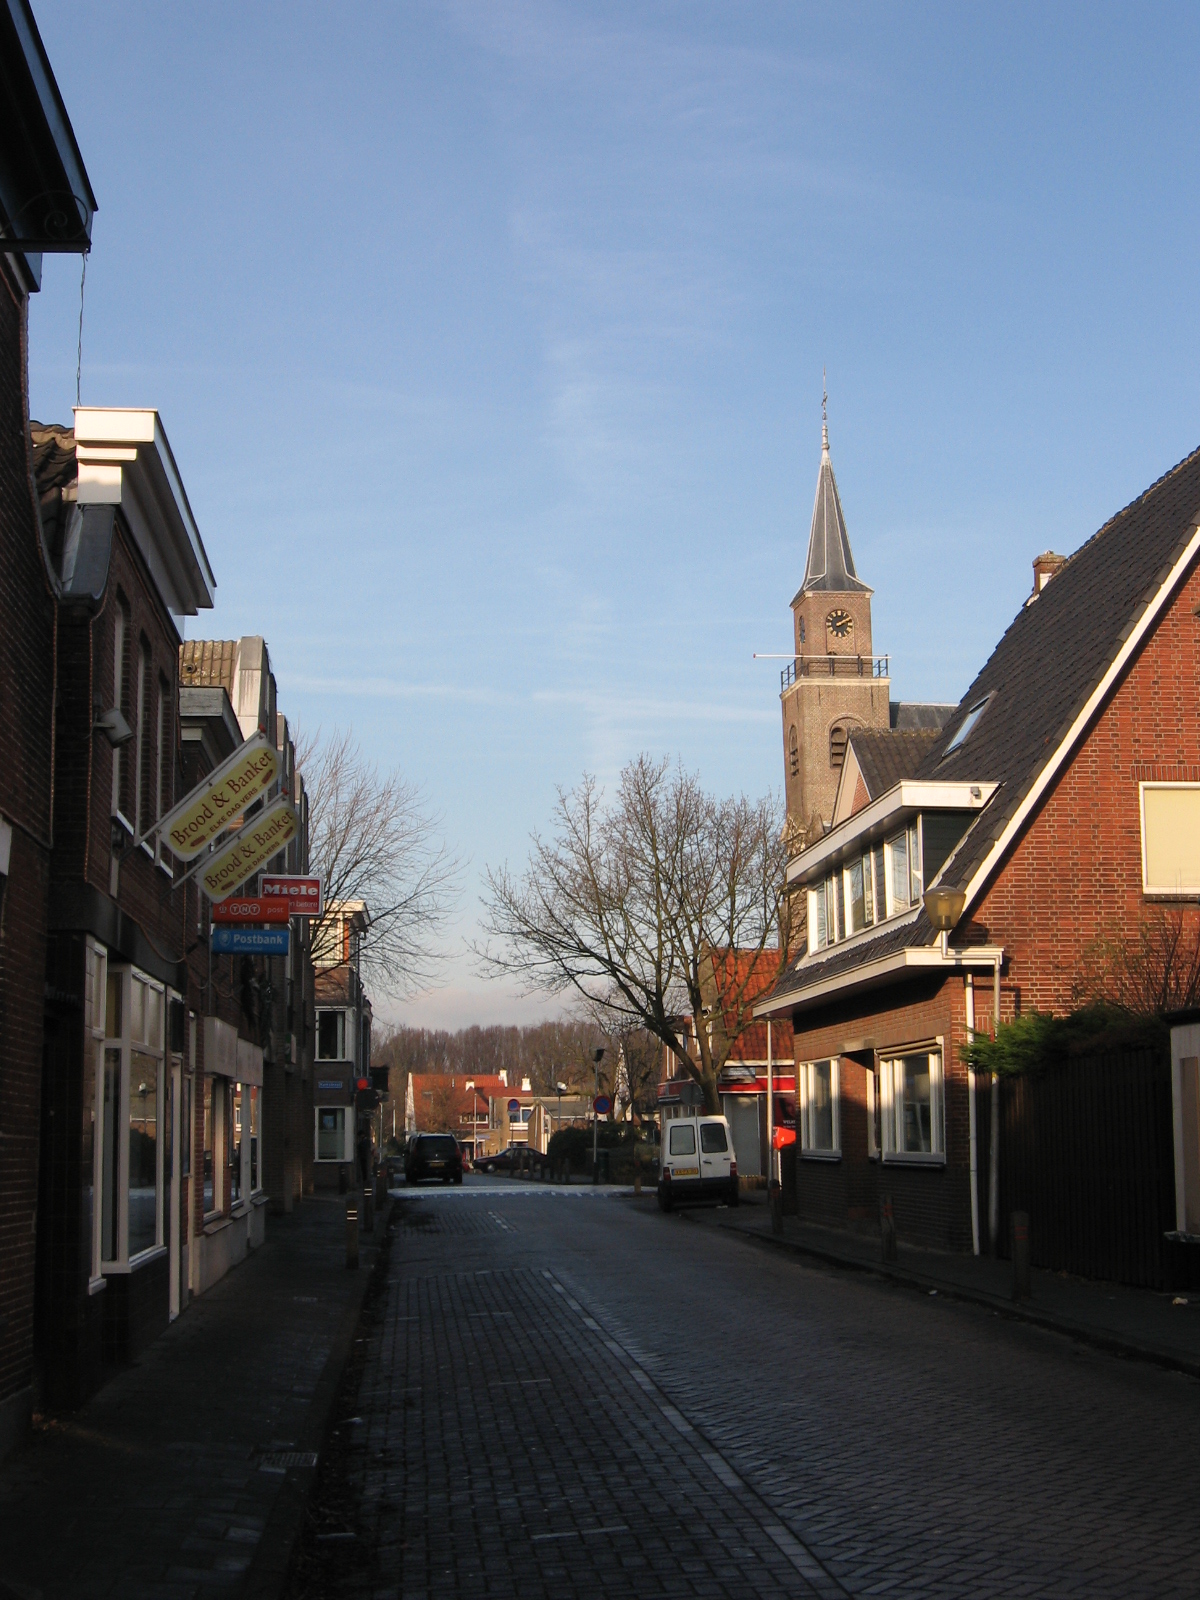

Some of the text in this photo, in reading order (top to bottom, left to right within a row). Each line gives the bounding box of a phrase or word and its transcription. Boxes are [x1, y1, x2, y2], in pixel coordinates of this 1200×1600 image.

[170, 751, 273, 846] Brood & Banket
[209, 787, 258, 833] ELKE DAG VERS
[205, 811, 293, 889] Brood & Banket
[237, 841, 280, 879] ELKE DAG VERS
[263, 884, 318, 896] Miele
[231, 905, 284, 915] TNT post
[296, 900, 317, 908] betere
[233, 934, 283, 944] Postbank
